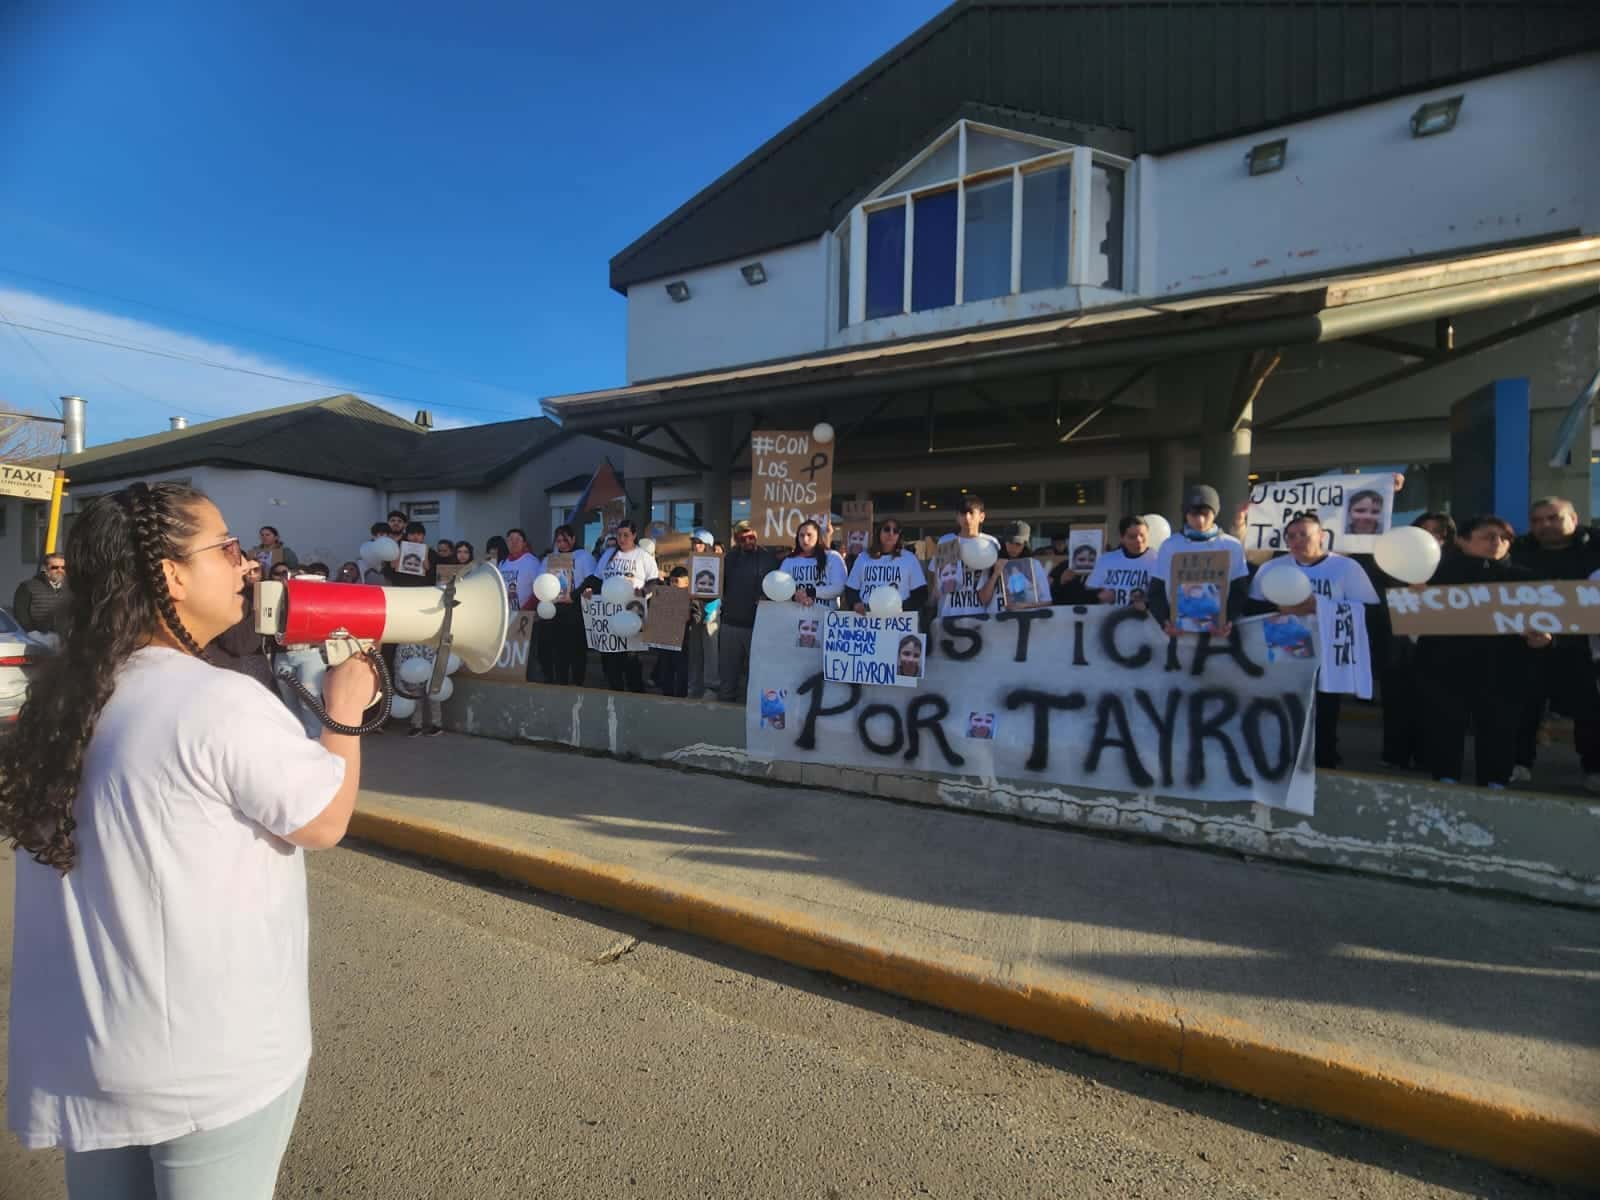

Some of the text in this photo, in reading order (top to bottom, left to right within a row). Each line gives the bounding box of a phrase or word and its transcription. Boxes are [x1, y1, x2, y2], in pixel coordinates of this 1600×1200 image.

[752, 434, 809, 455] #CON
[2, 467, 42, 482] TAXI
[757, 459, 788, 478] LOS
[764, 478, 817, 505] NIÑOS
[864, 566, 902, 581] JUSTICIA
[1104, 569, 1149, 587] JUSTICIA
[1387, 585, 1490, 614] #CON
[1501, 585, 1565, 607] LOS
[828, 611, 850, 629] QUE
[885, 617, 913, 632] PASE
[828, 629, 835, 640] A
[825, 653, 896, 685] LEY TAYRON
[795, 672, 965, 767] POR
